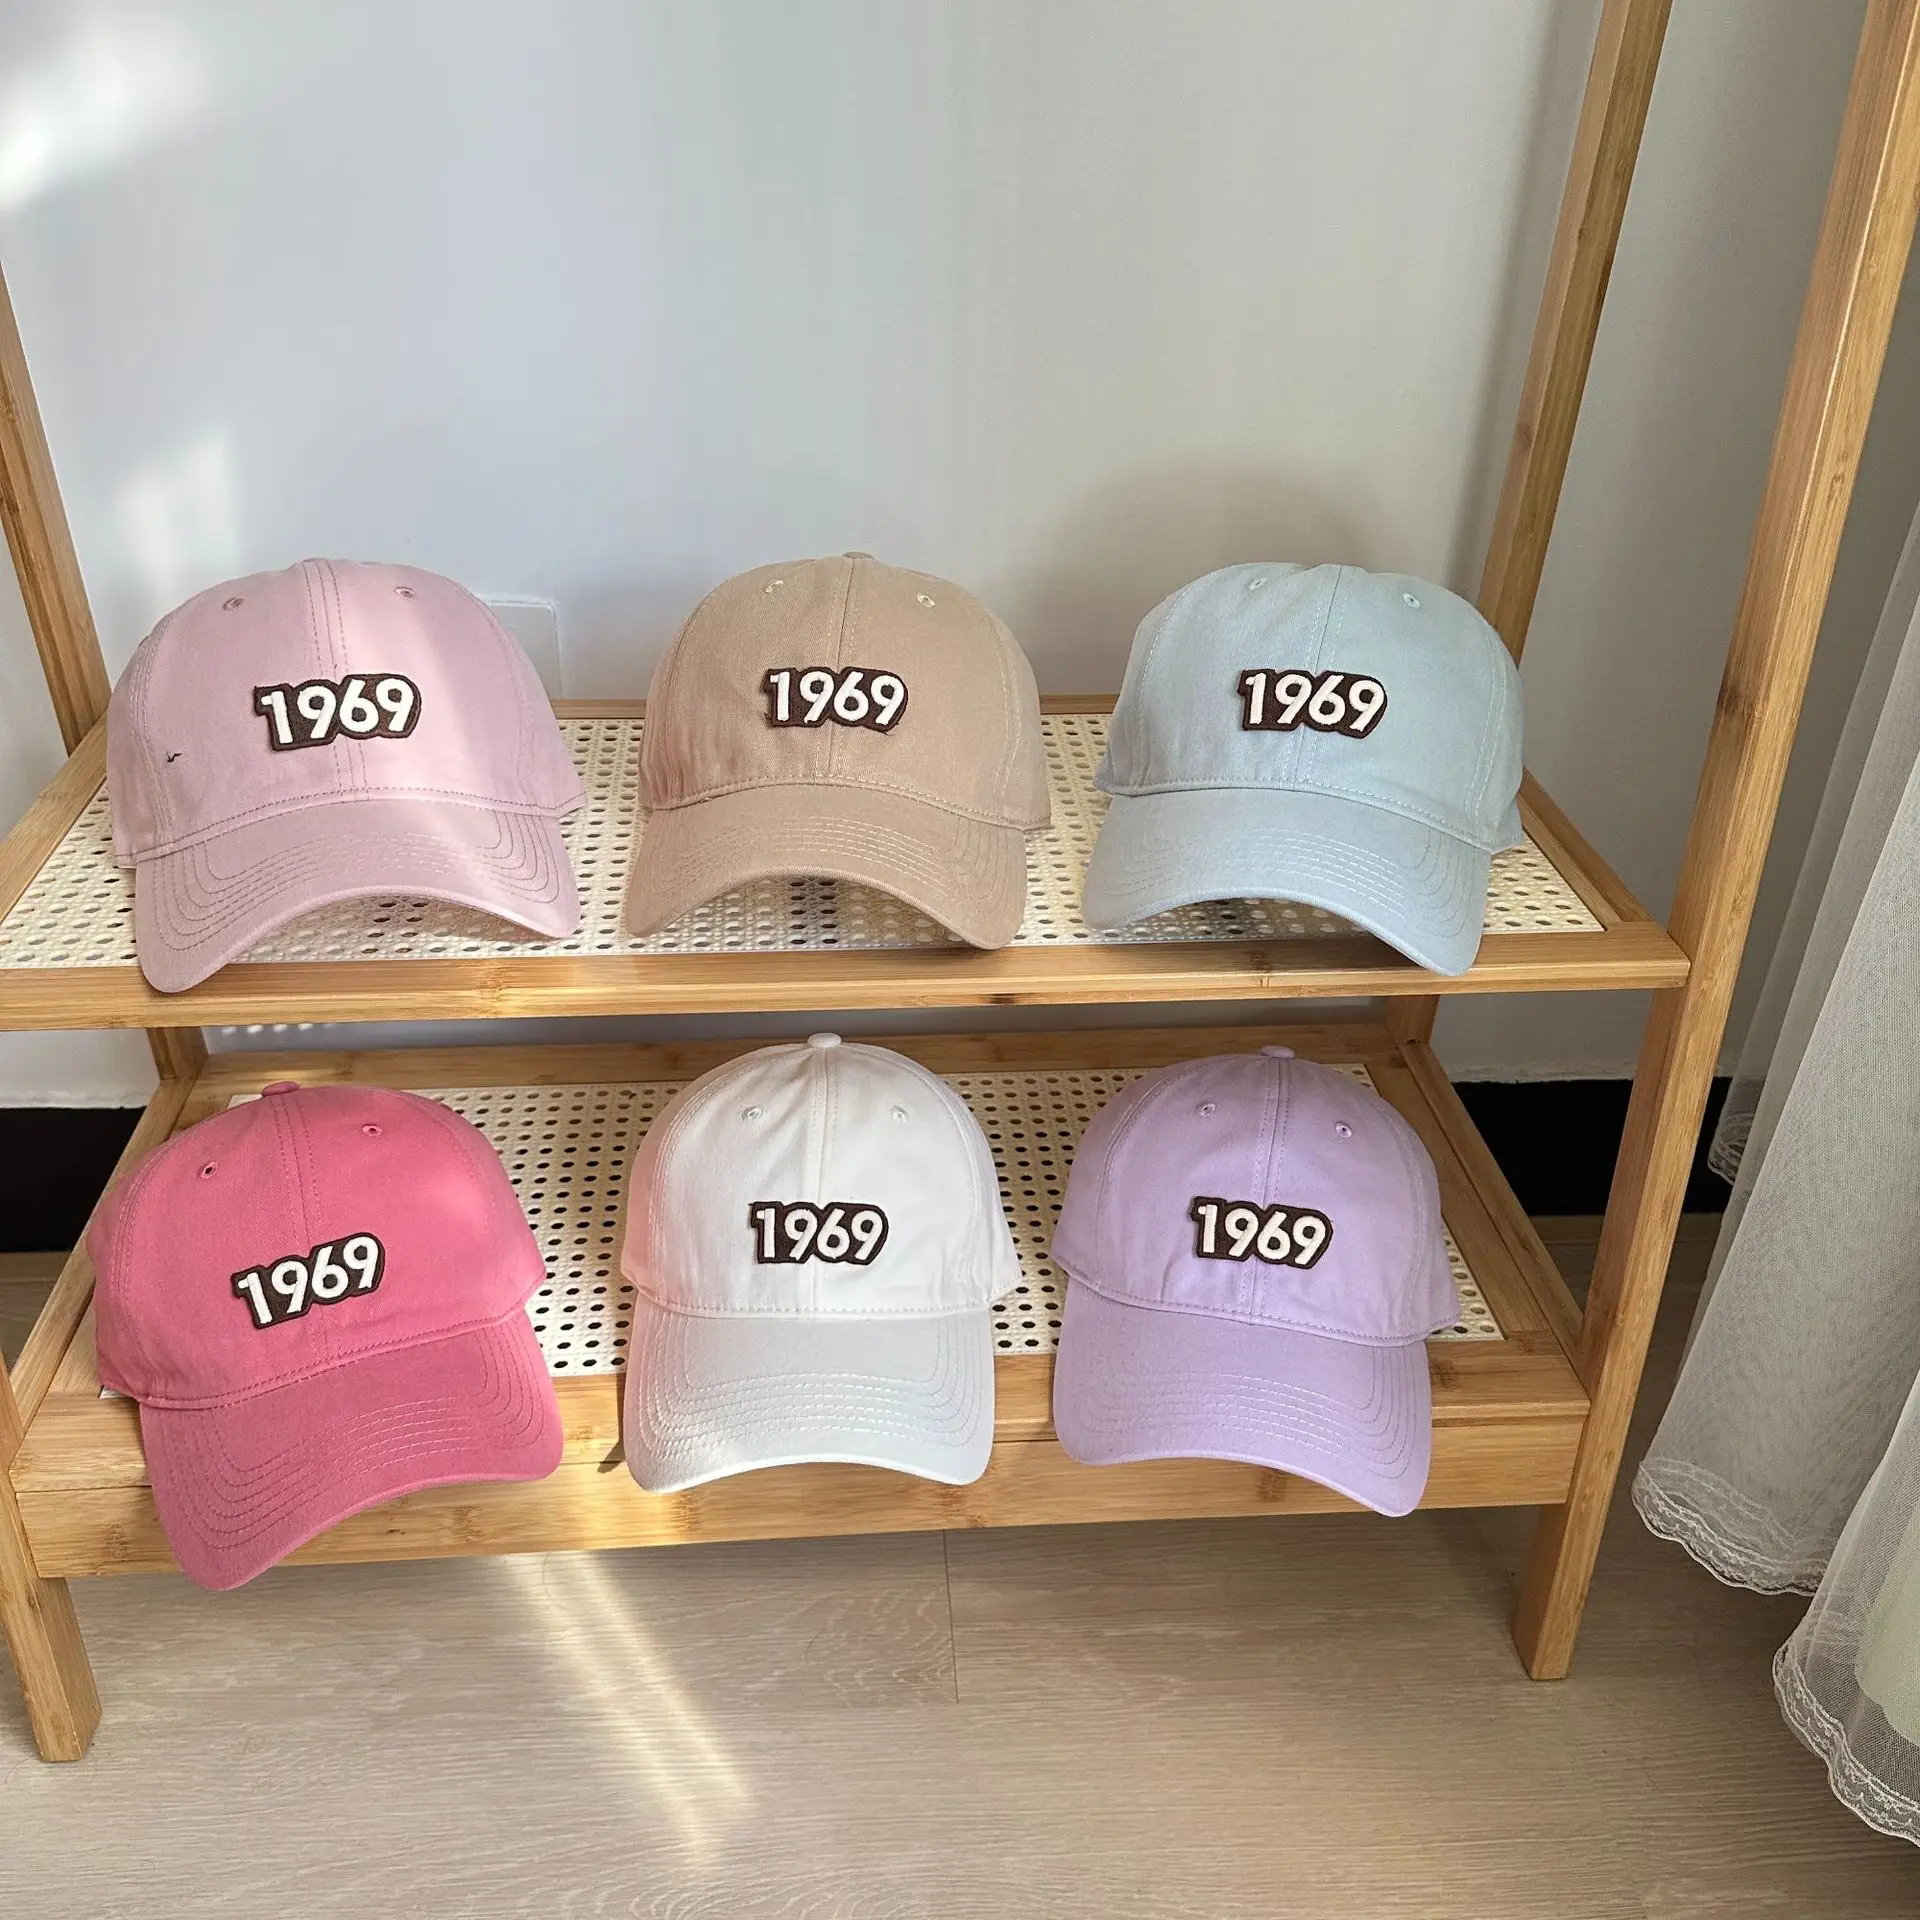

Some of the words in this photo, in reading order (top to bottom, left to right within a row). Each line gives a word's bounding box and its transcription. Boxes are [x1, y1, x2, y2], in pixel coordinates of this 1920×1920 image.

[261, 678, 414, 744] 1969
[770, 671, 905, 725] 1969
[1245, 672, 1385, 732] 1969
[756, 1207, 884, 1261] 1969
[1197, 1204, 1326, 1266] 1969
[237, 1236, 380, 1325] 1969
